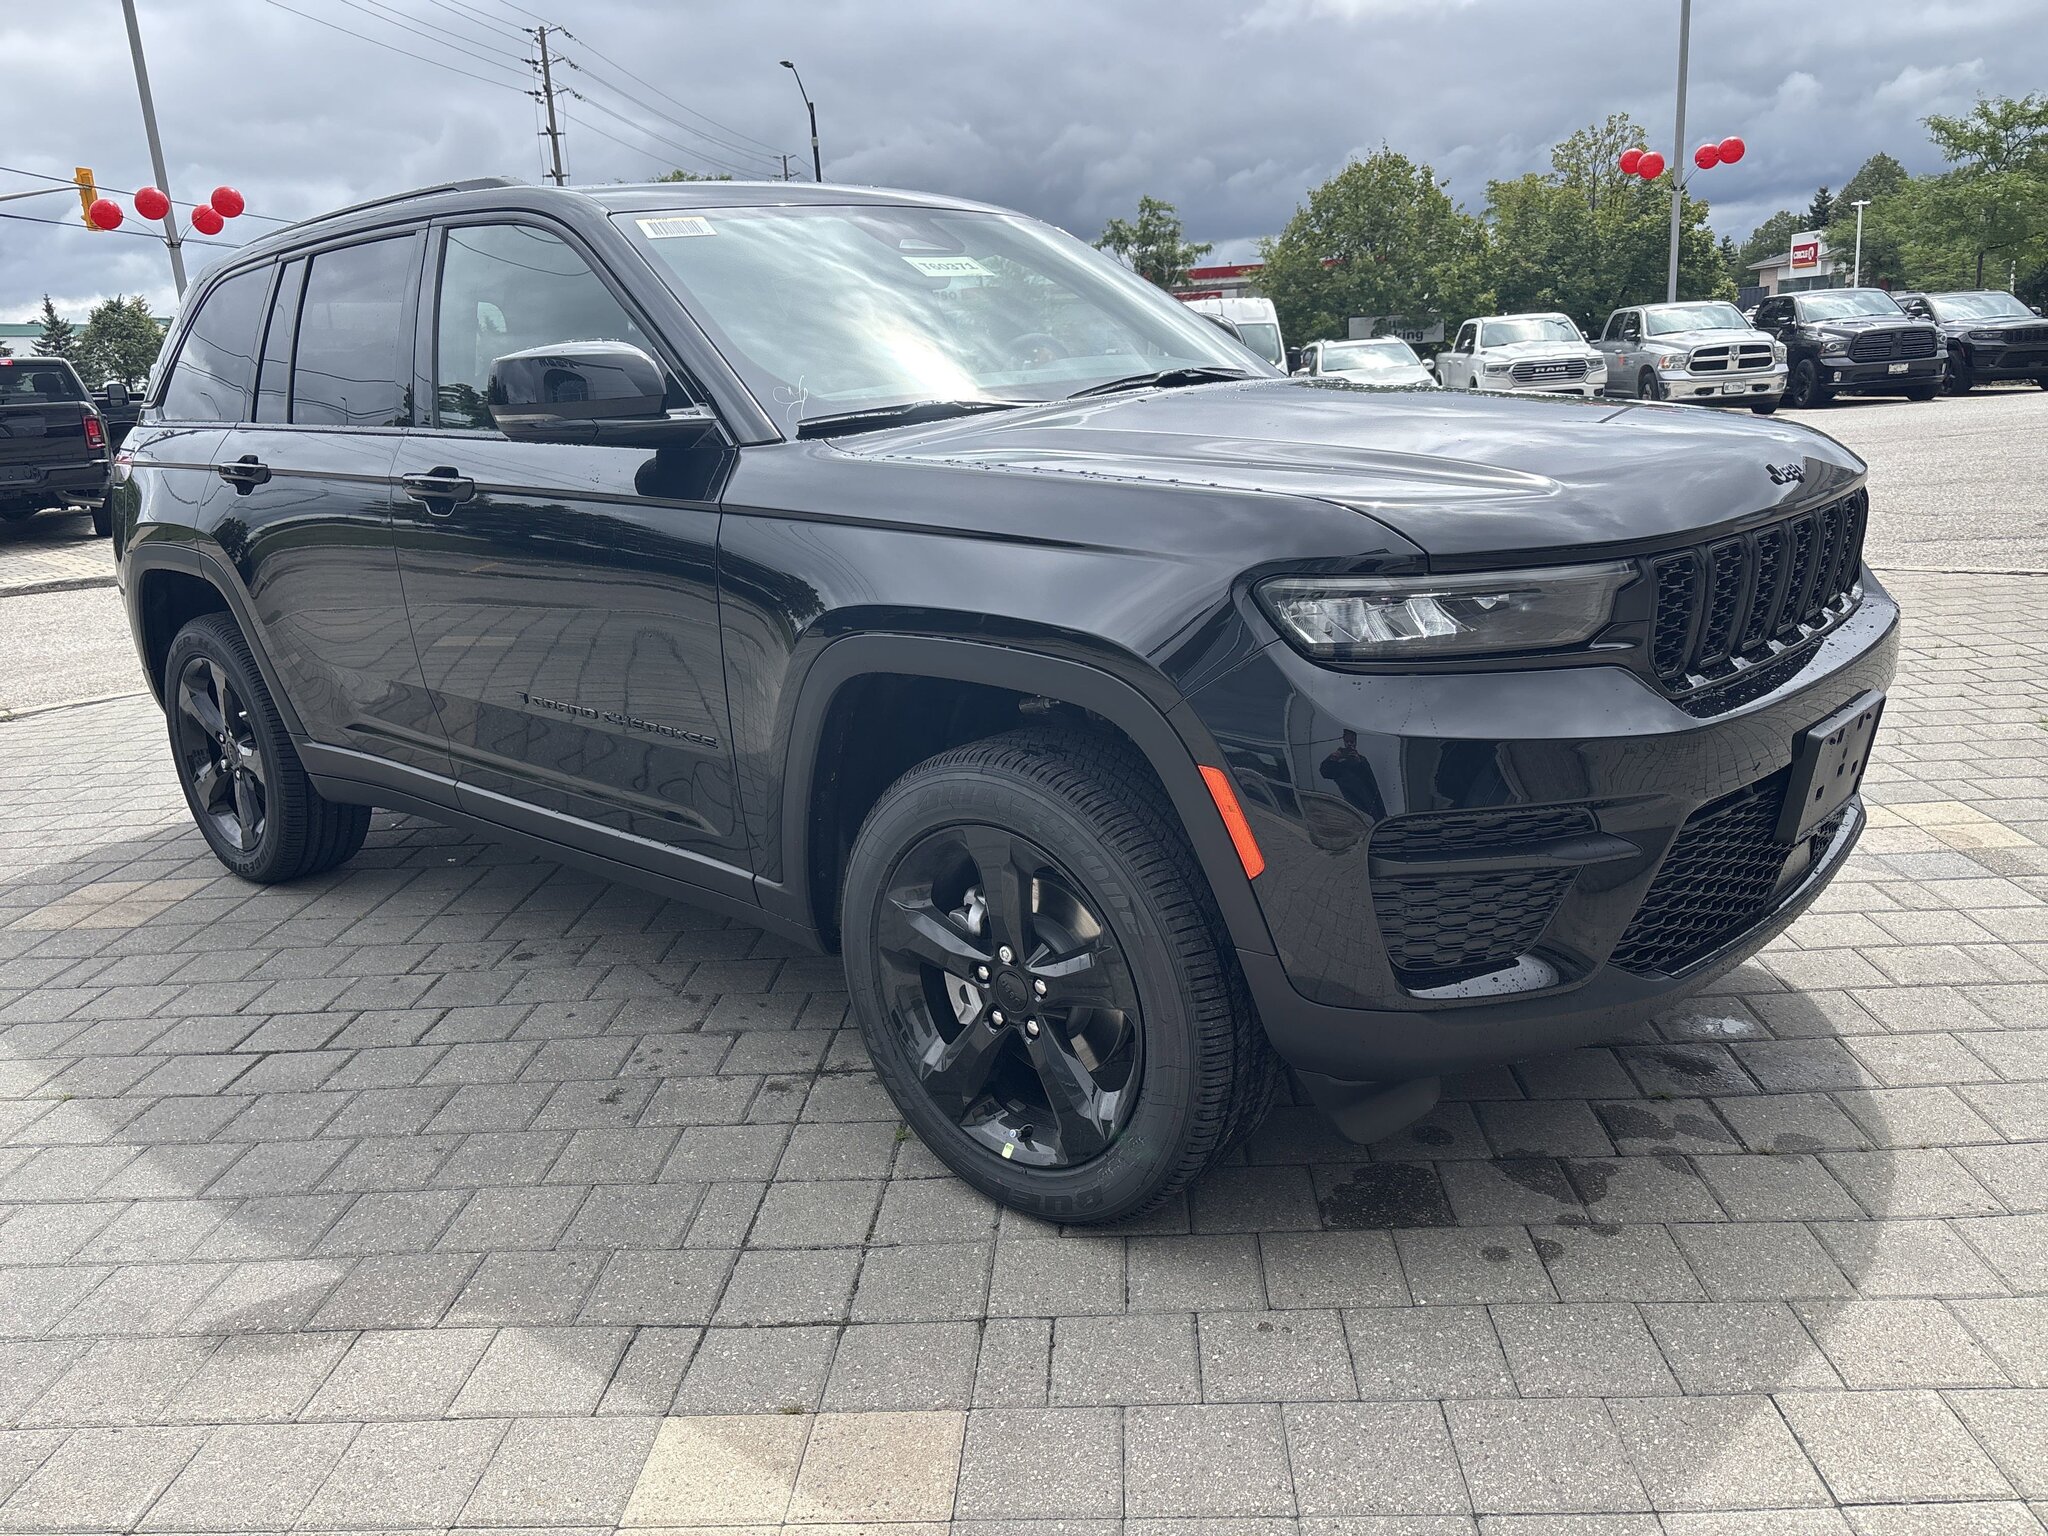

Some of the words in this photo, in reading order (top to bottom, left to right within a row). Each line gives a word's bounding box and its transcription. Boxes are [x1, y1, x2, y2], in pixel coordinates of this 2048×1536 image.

[1534, 365, 1567, 373] RAM
[1765, 463, 1806, 486] Jeep
[602, 710, 719, 750] CHEROKEE
